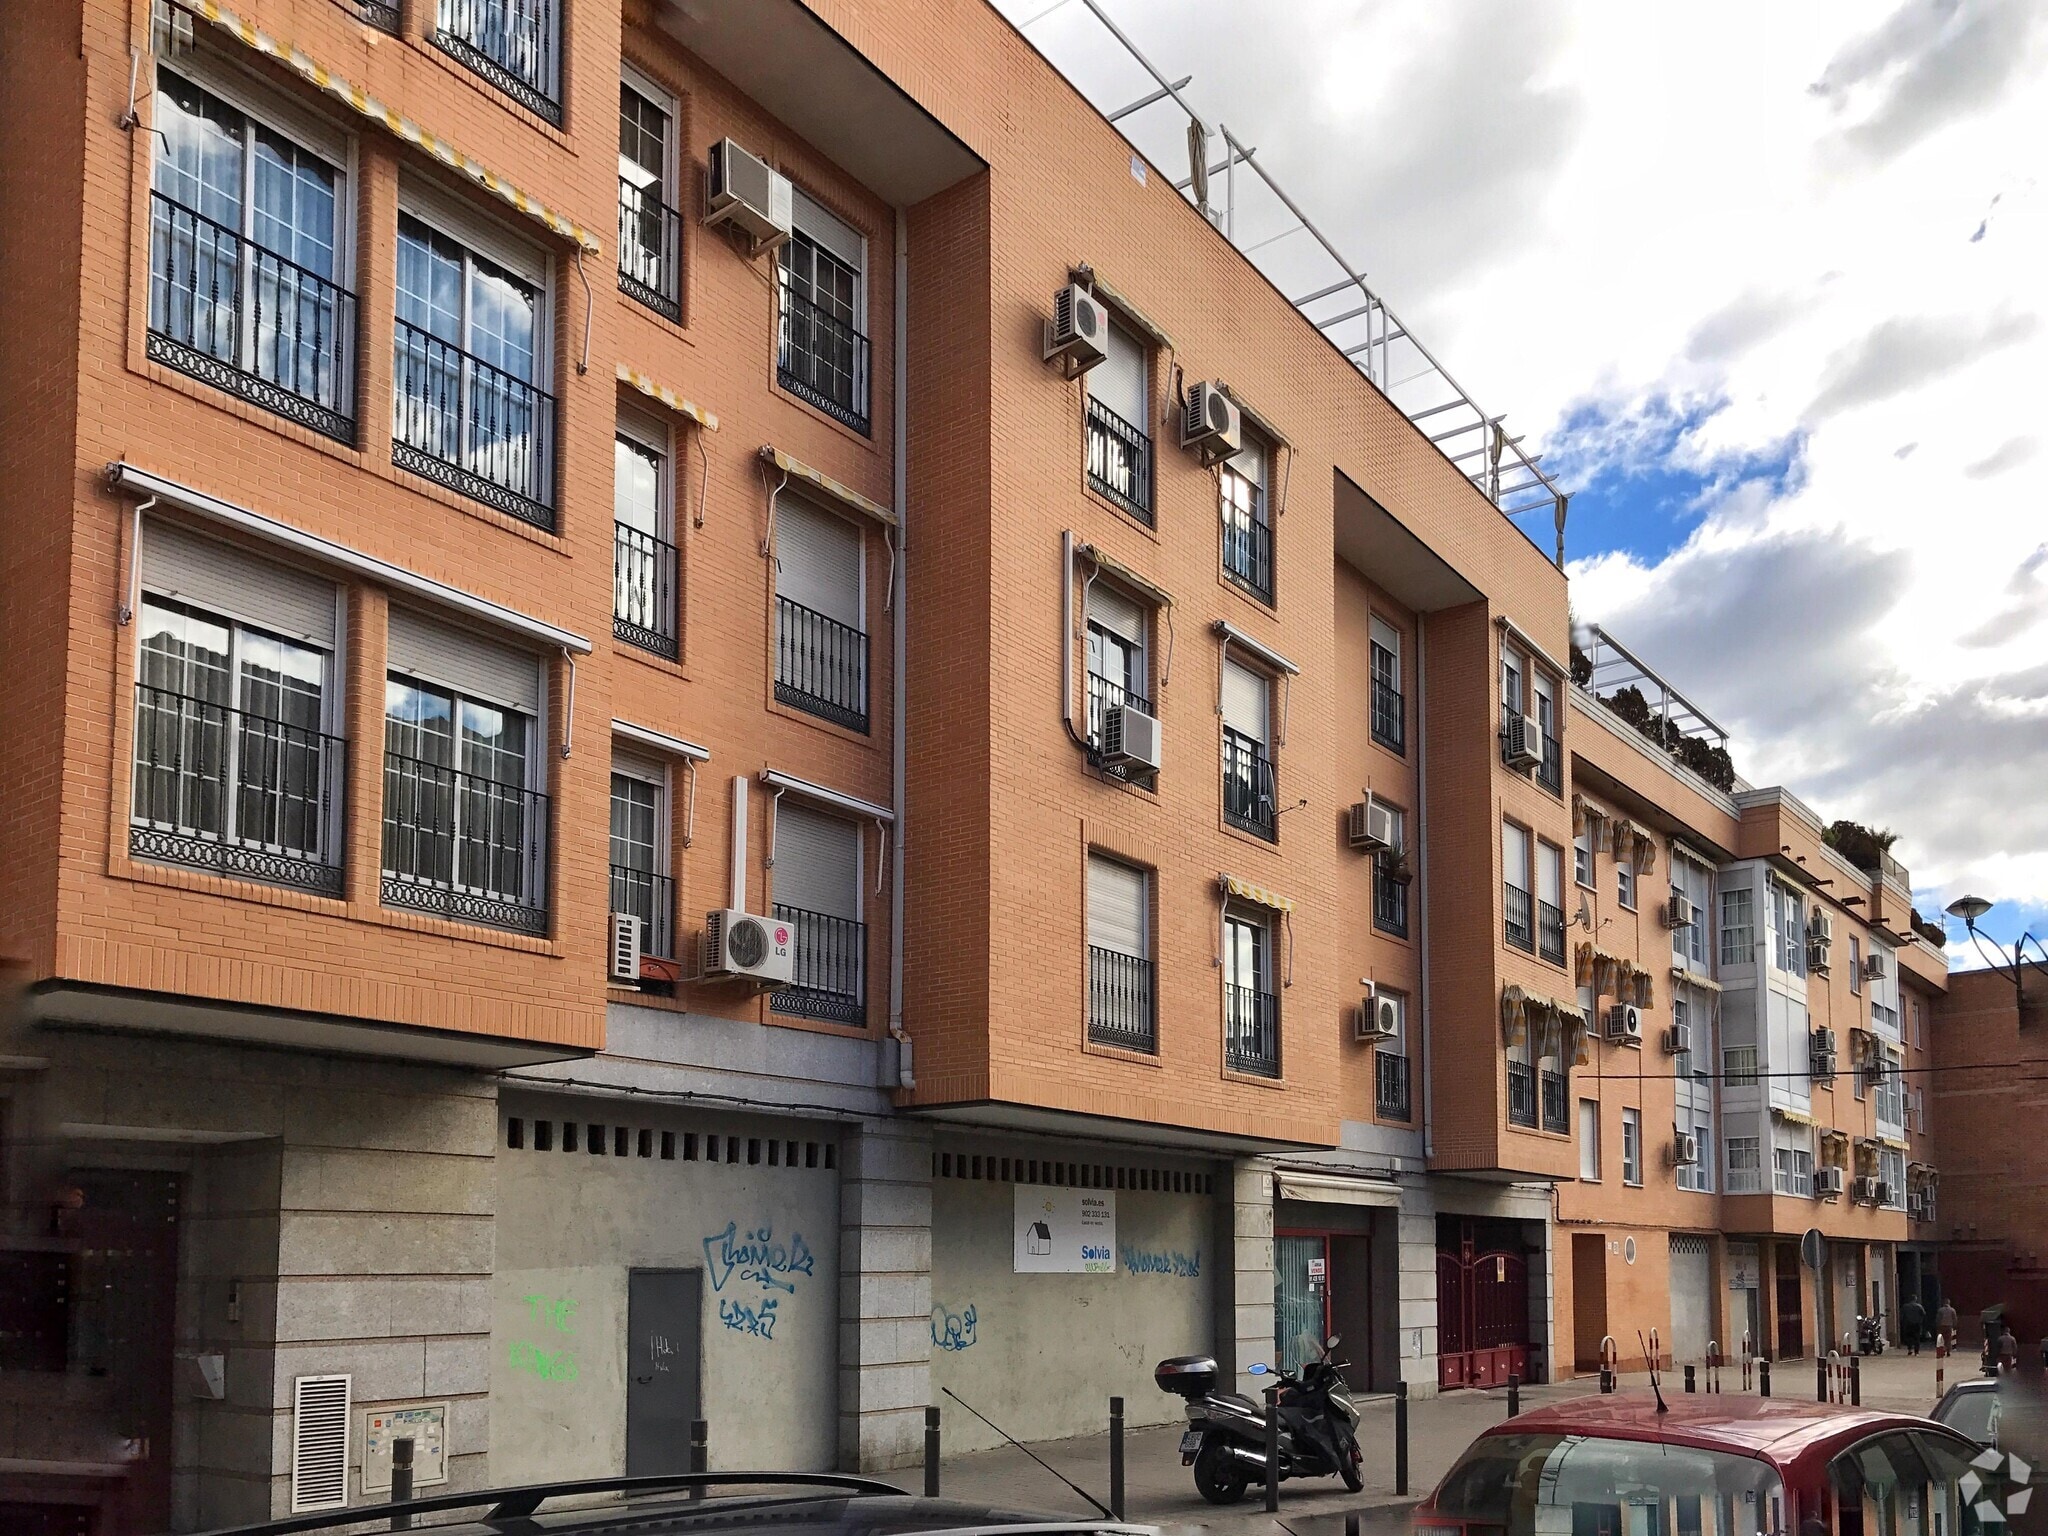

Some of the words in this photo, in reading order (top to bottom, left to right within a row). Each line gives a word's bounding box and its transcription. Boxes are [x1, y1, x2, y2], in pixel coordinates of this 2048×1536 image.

[775, 947, 786, 957] LG
[1082, 1198, 1104, 1206] solvia.es
[1081, 1209, 1091, 1217] 902
[1081, 1245, 1110, 1260] Solvia
[522, 1294, 580, 1335] THE
[508, 1339, 579, 1382] KINGS
